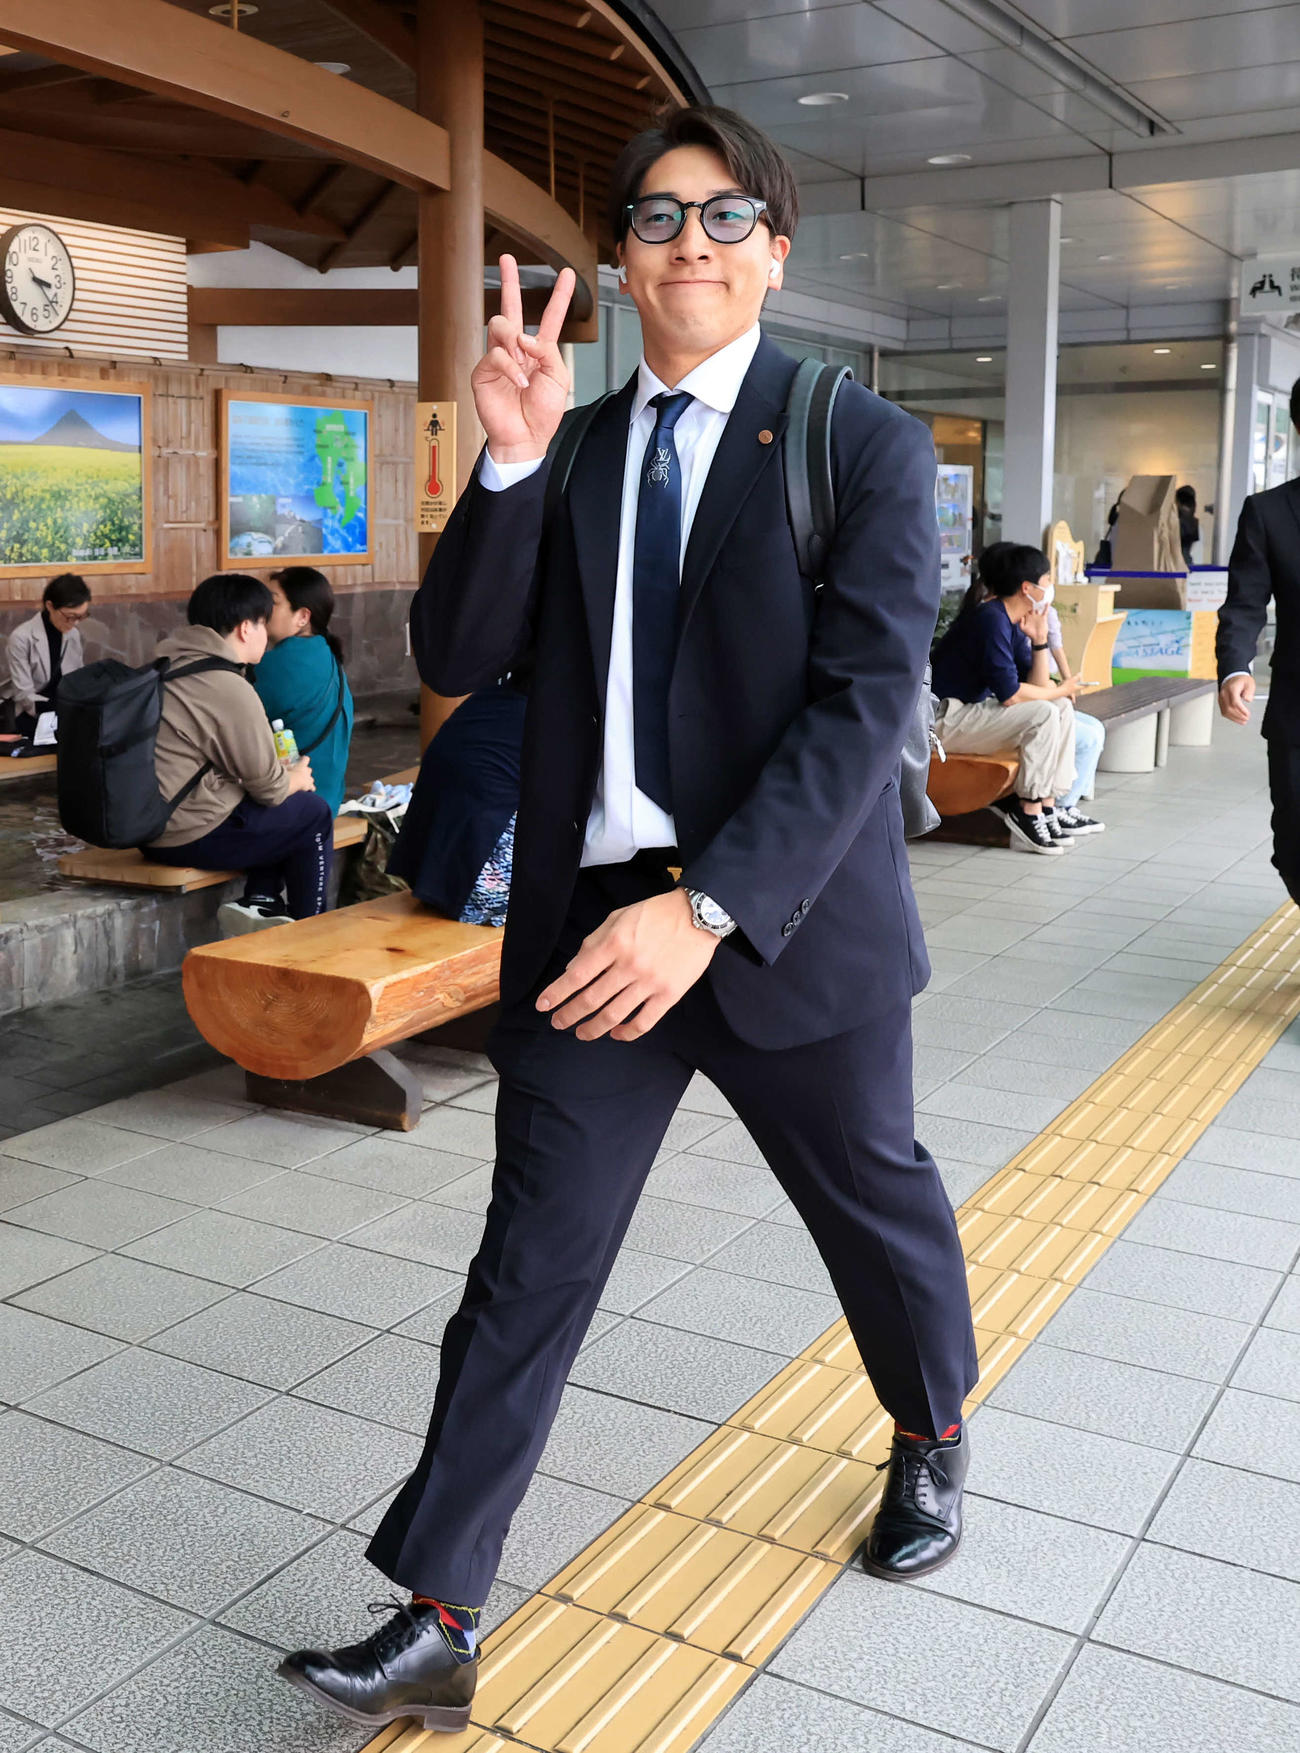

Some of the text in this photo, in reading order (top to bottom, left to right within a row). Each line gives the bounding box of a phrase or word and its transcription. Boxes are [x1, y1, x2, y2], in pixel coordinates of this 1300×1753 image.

[19, 238, 27, 254] 11
[28, 235, 40, 251] 12
[8, 251, 19, 267] 10
[51, 255, 60, 271] 2
[5, 268, 14, 284] 9
[54, 274, 63, 290] 3
[9, 286, 18, 302] 8
[50, 292, 59, 305] 4
[20, 302, 28, 317] 7
[30, 306, 39, 322] 6
[42, 304, 52, 319] 5
